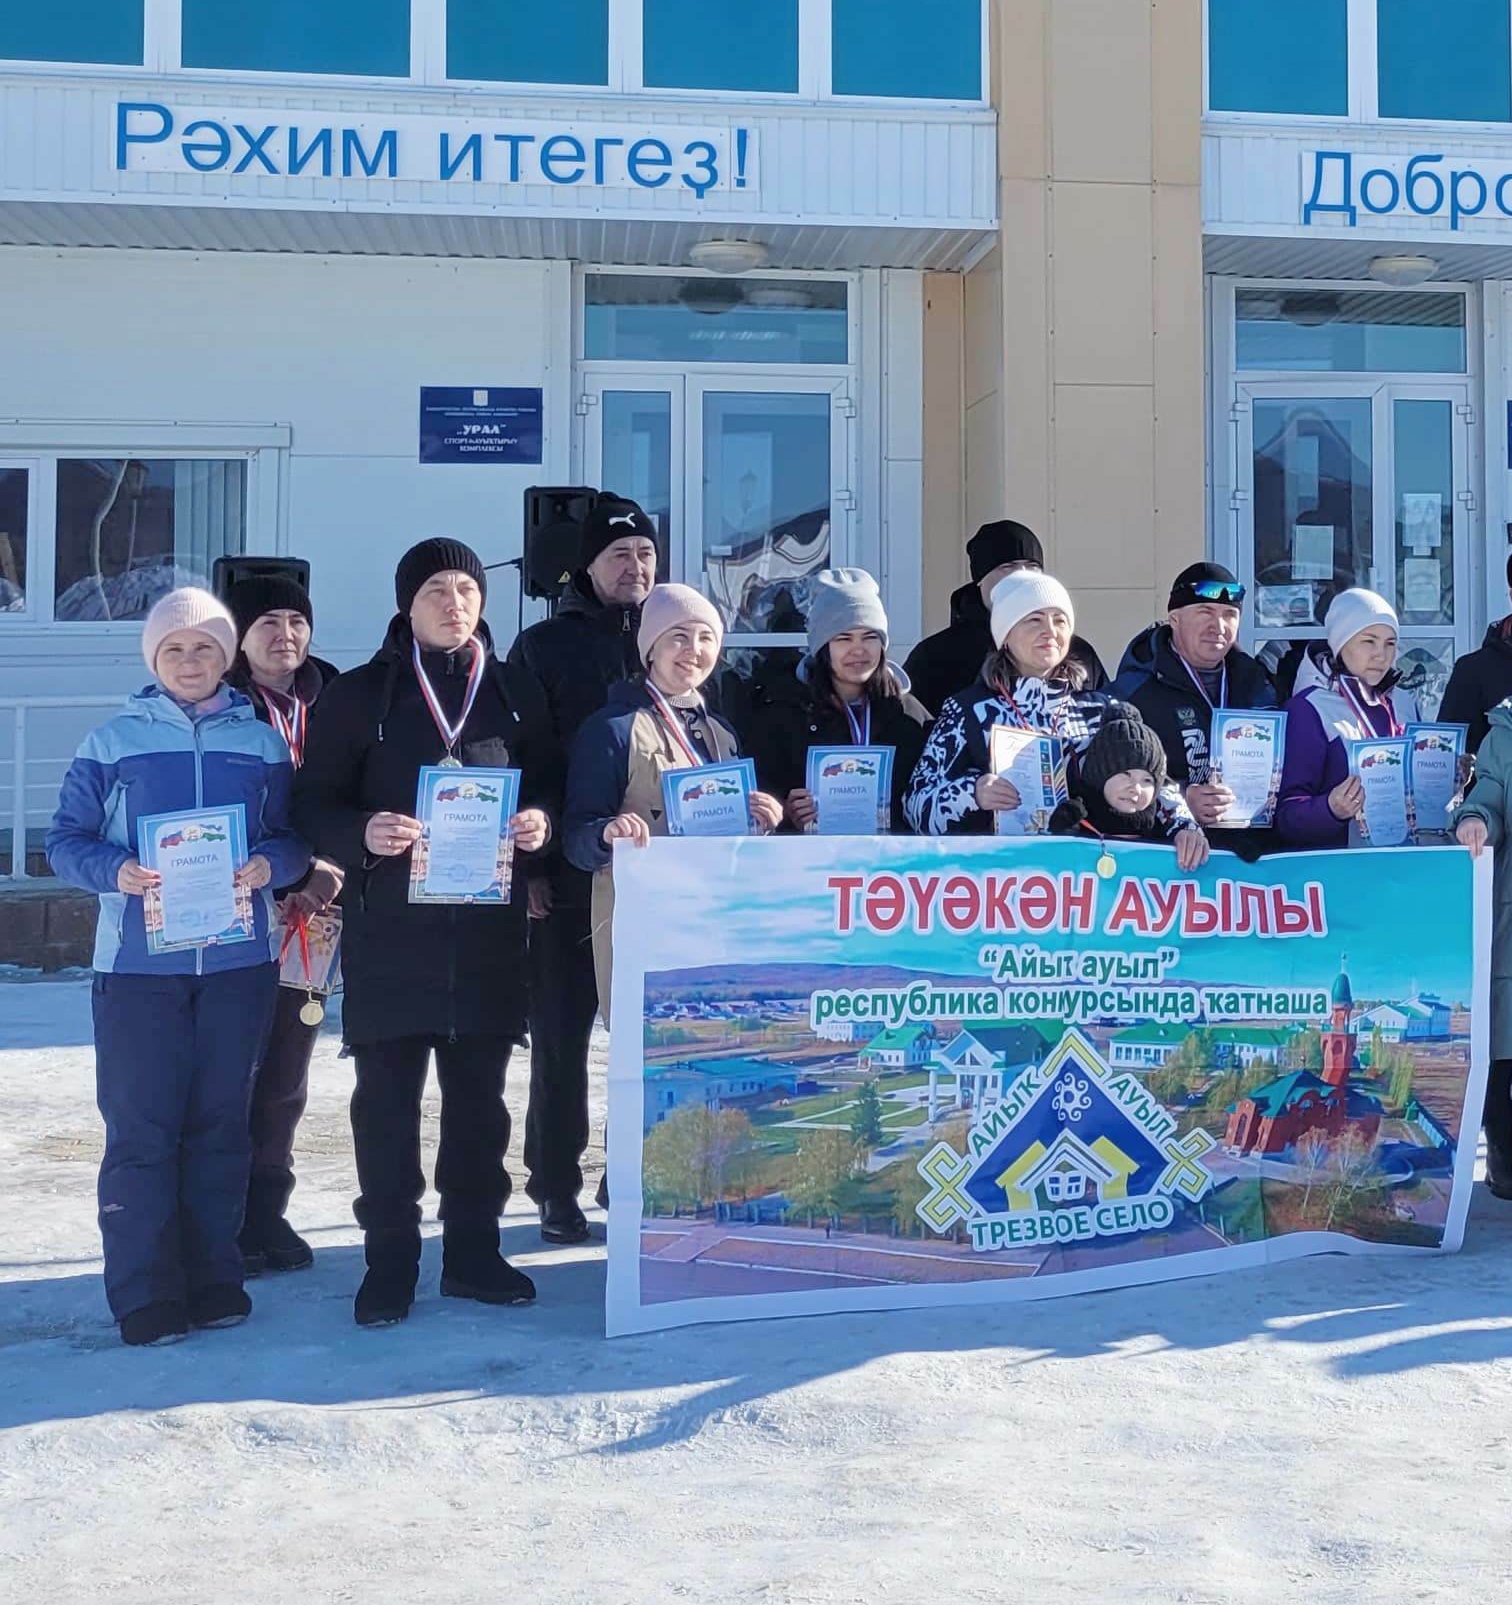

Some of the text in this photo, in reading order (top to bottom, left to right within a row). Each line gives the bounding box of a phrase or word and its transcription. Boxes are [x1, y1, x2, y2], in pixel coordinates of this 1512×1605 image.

[117, 102, 397, 178] Рәхим
[828, 786, 868, 796] ГРАМОТА
[443, 812, 489, 822] ГРАМОТА
[692, 805, 735, 820] ГРАМОТА
[170, 854, 219, 868] ГРАМОТА
[828, 876, 1325, 934] ТӘҮӘКӘН АУЫЛЫ
[815, 985, 997, 1023] республика
[1108, 1077, 1173, 1140] АУЫЛ
[971, 1200, 1169, 1247] ТРЕЗВОЕ СЕЛО
